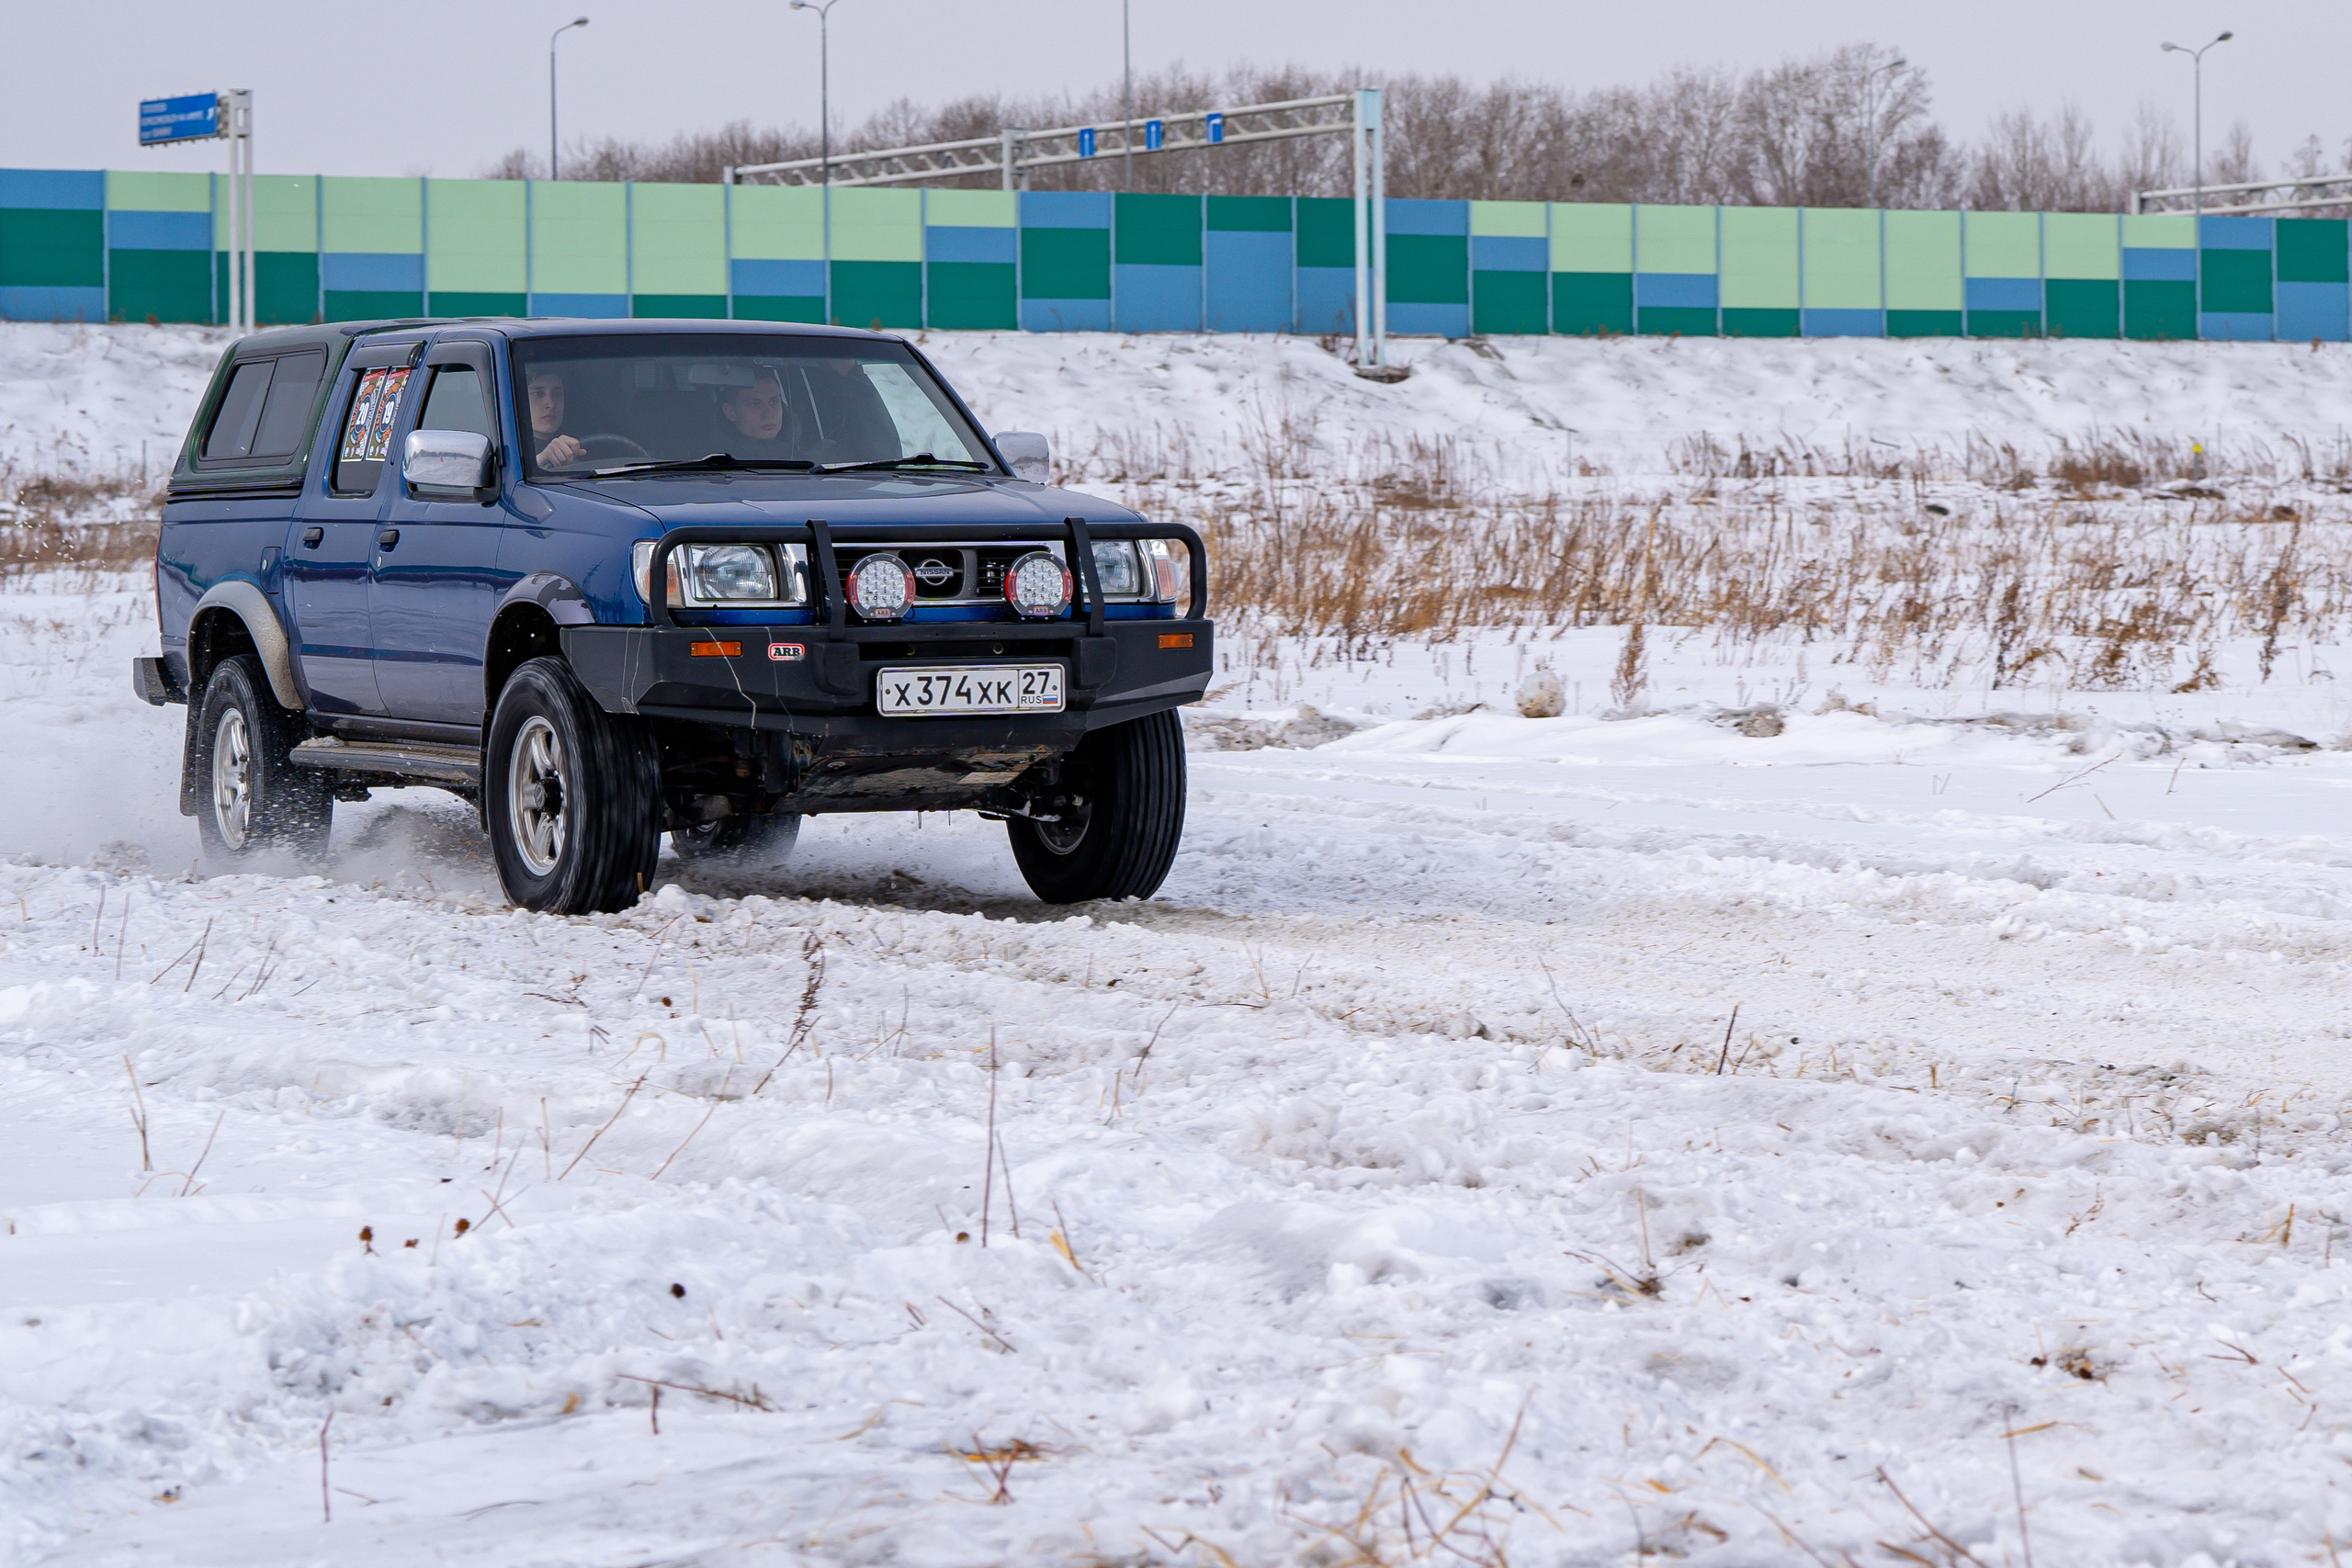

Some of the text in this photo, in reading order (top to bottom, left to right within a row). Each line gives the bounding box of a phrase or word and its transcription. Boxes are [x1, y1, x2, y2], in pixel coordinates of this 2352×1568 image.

[356, 401, 370, 425] 20
[382, 400, 395, 424] 19
[773, 647, 800, 657] ARB
[1022, 671, 1051, 695] 27
[1021, 695, 1043, 705] RUS
